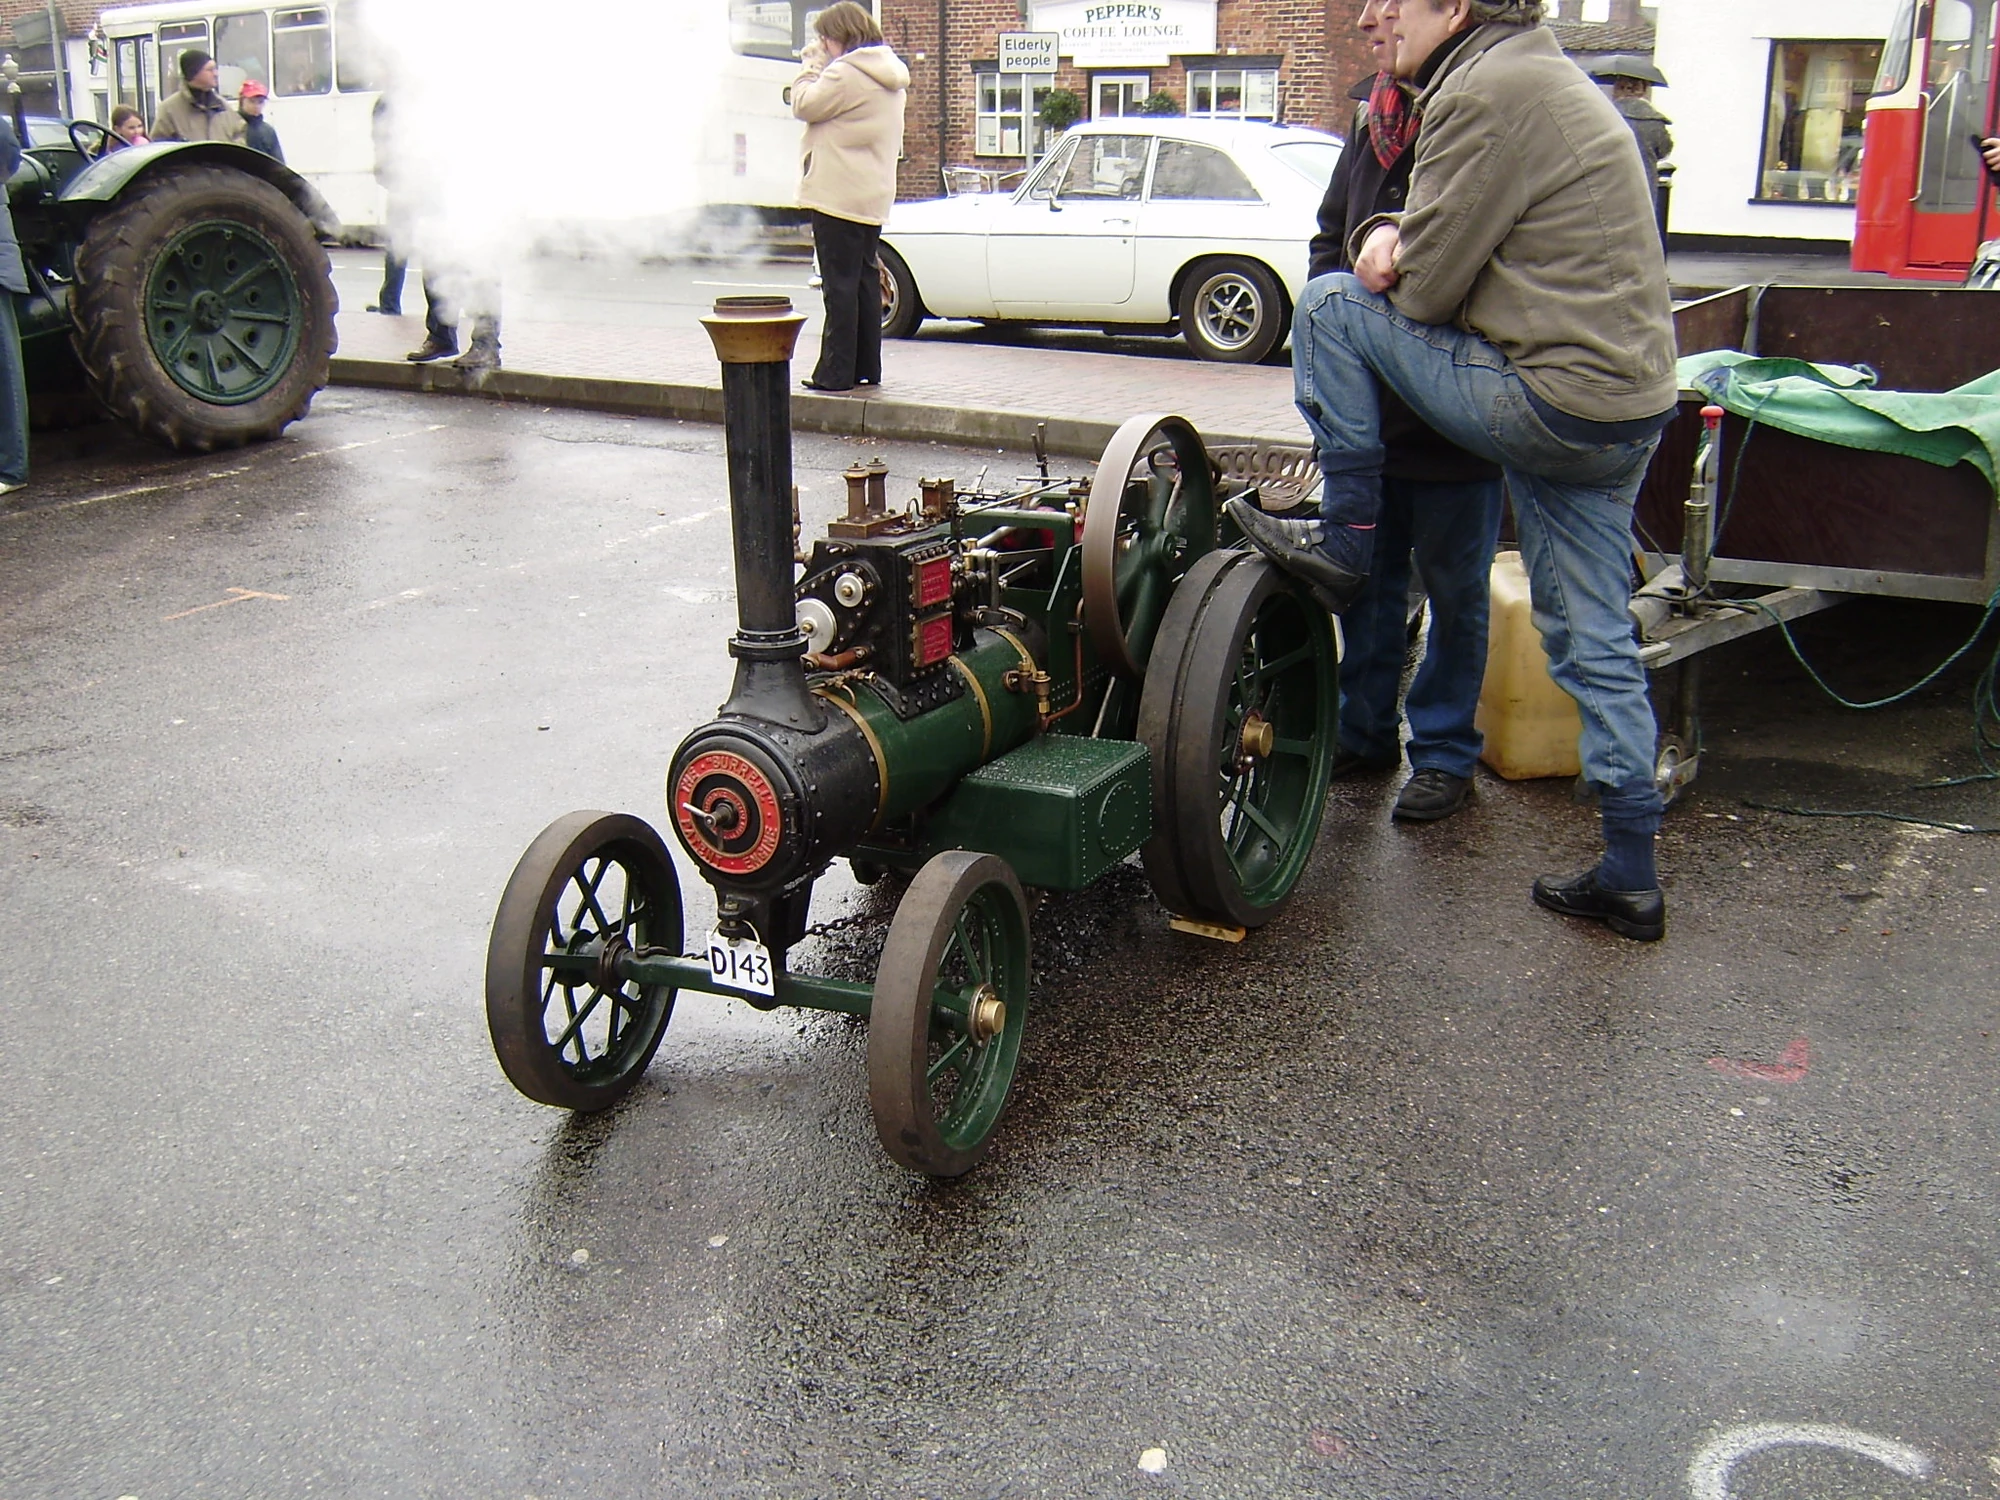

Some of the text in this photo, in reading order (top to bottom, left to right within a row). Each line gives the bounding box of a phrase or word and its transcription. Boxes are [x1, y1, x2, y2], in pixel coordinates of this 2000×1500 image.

[1085, 4, 1162, 23] PEPPER'S
[1063, 24, 1184, 38] COFFEE LOUNGE
[1005, 39, 1051, 52] Elderly
[1006, 54, 1051, 67] people
[681, 766, 700, 793] THE
[711, 946, 769, 985] D143
